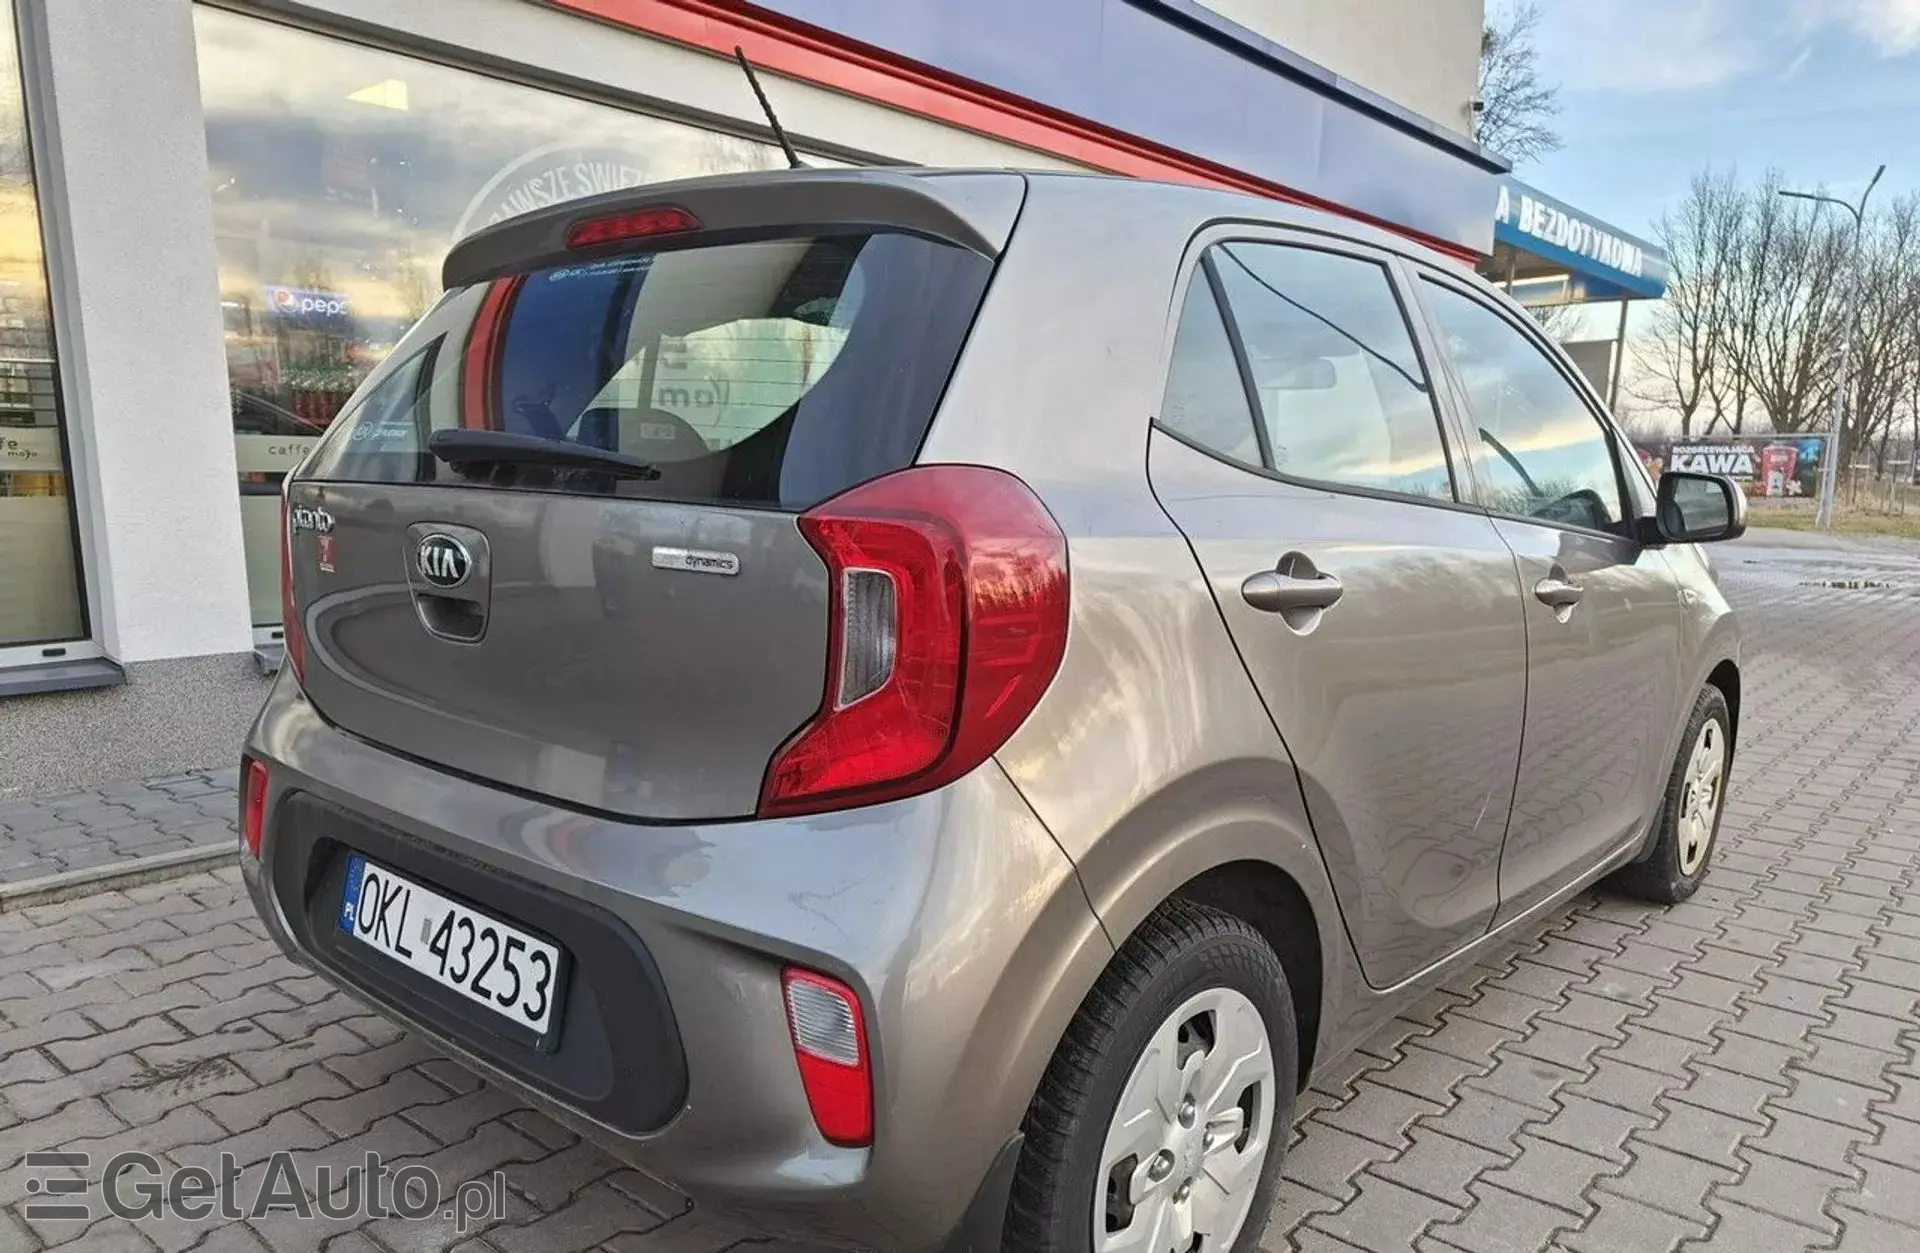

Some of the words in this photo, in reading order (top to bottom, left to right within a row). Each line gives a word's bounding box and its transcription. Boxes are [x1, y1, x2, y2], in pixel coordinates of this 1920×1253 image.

[1518, 194, 1643, 278] BEZDOTYKOWA
[267, 443, 311, 456] caffe
[1670, 454, 1754, 474] KAWA
[420, 545, 460, 579] KIA
[343, 901, 355, 921] PL
[358, 872, 413, 960] OKL
[429, 909, 552, 1021] 43253
